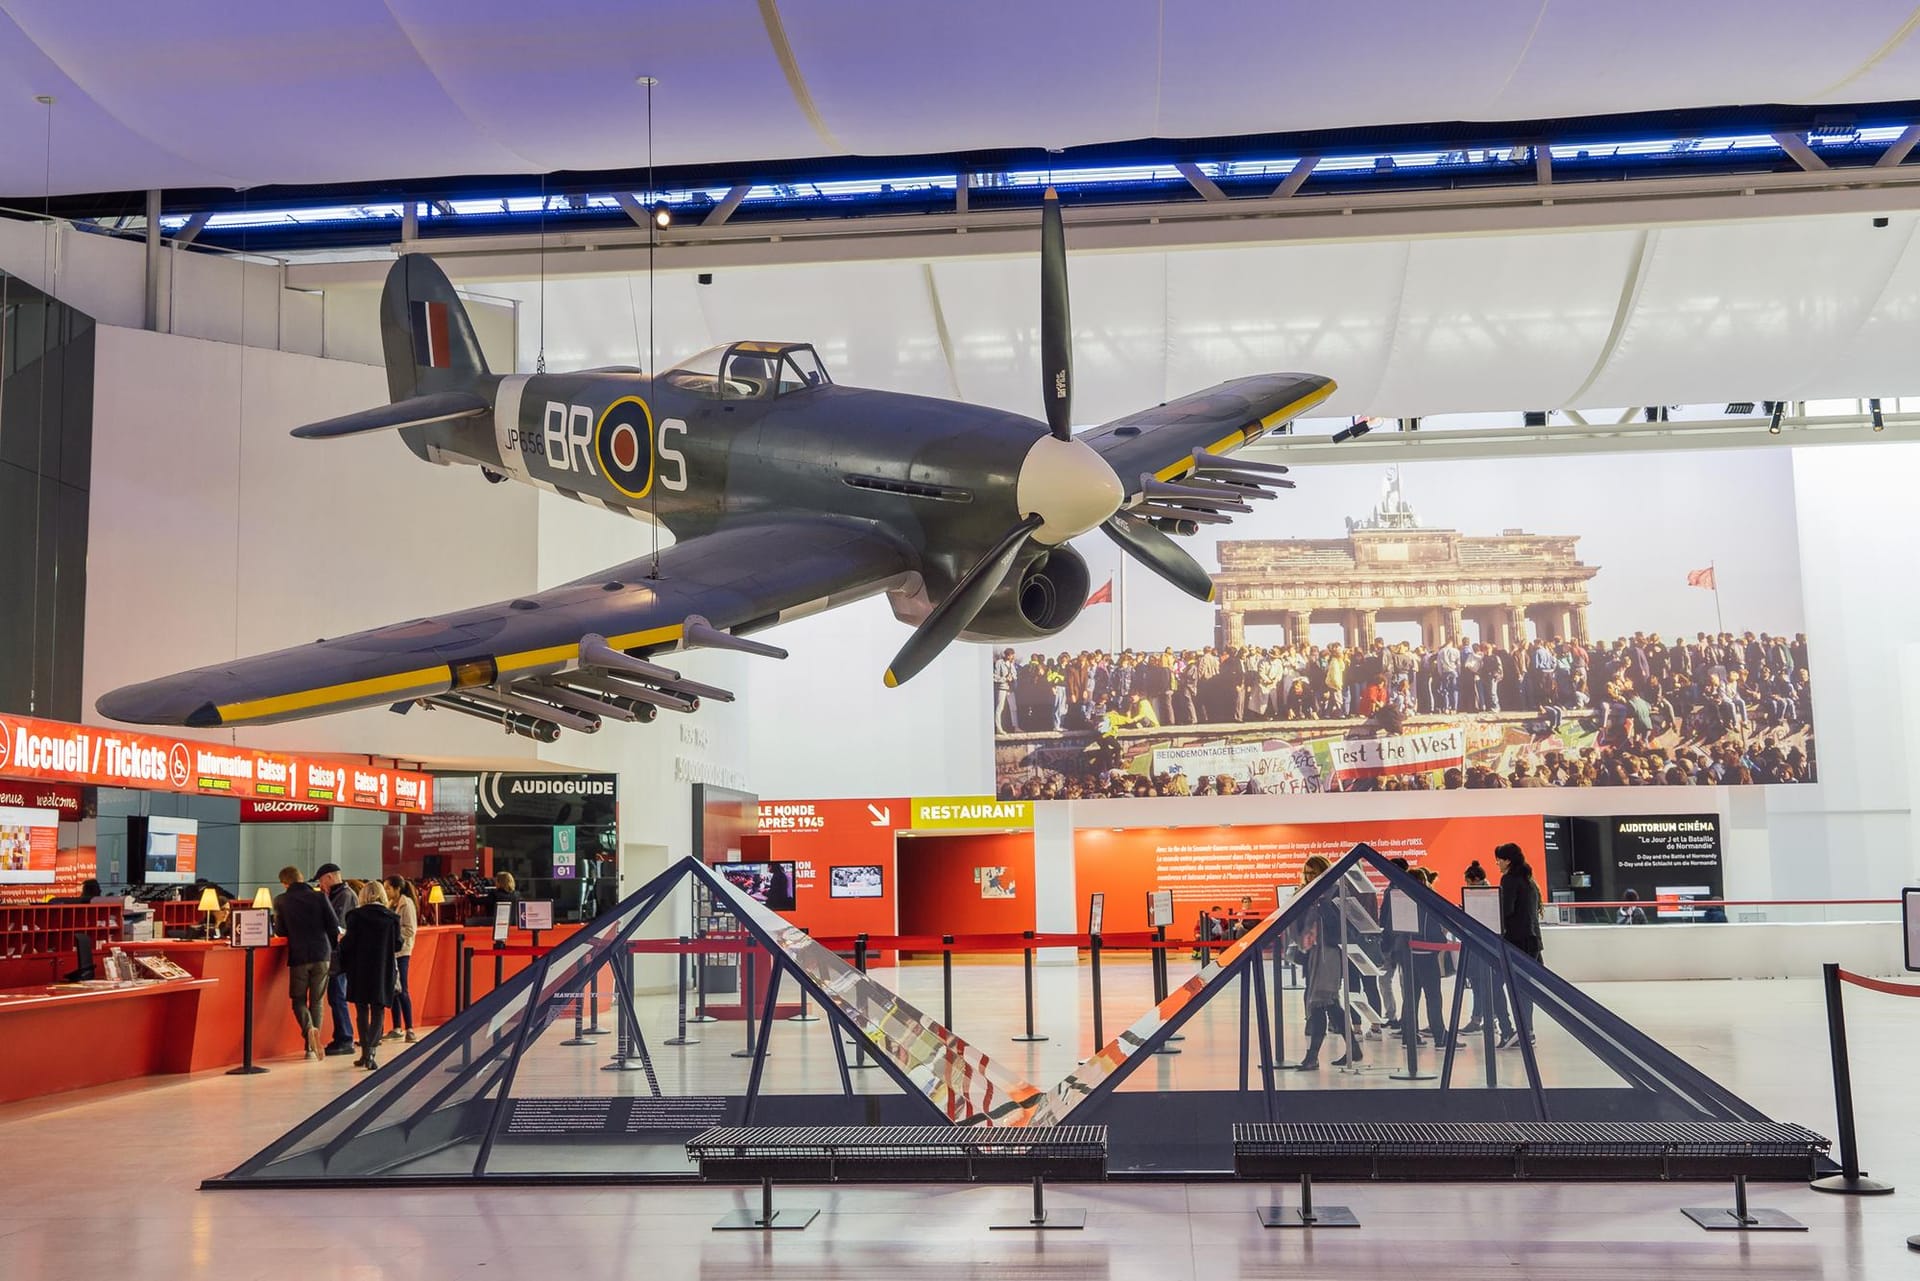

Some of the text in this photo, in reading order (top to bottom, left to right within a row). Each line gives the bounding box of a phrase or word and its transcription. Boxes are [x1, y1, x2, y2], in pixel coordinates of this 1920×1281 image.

[505, 400, 688, 492] JP656 BR S
[14, 726, 89, 773] Accueil
[105, 738, 167, 781] Tickets
[1335, 743, 1367, 764] Test
[1376, 741, 1405, 761] the
[196, 750, 253, 779] Information
[256, 757, 287, 783] Caisse
[289, 762, 297, 798] 1
[308, 763, 346, 803] Caisse 2
[354, 770, 388, 806] Caisse 3
[510, 780, 614, 795] AUDIOGUIDE
[395, 776, 418, 797] Caisse
[417, 780, 426, 811] 4
[253, 801, 320, 813] welcome,
[758, 805, 815, 816] LE MONDE
[920, 804, 1025, 820] RESTAURANT
[758, 814, 824, 828] APRÈS 1945
[1619, 820, 1715, 833] AUDITORIUM CINÉMA
[1651, 836, 1665, 844] Jour
